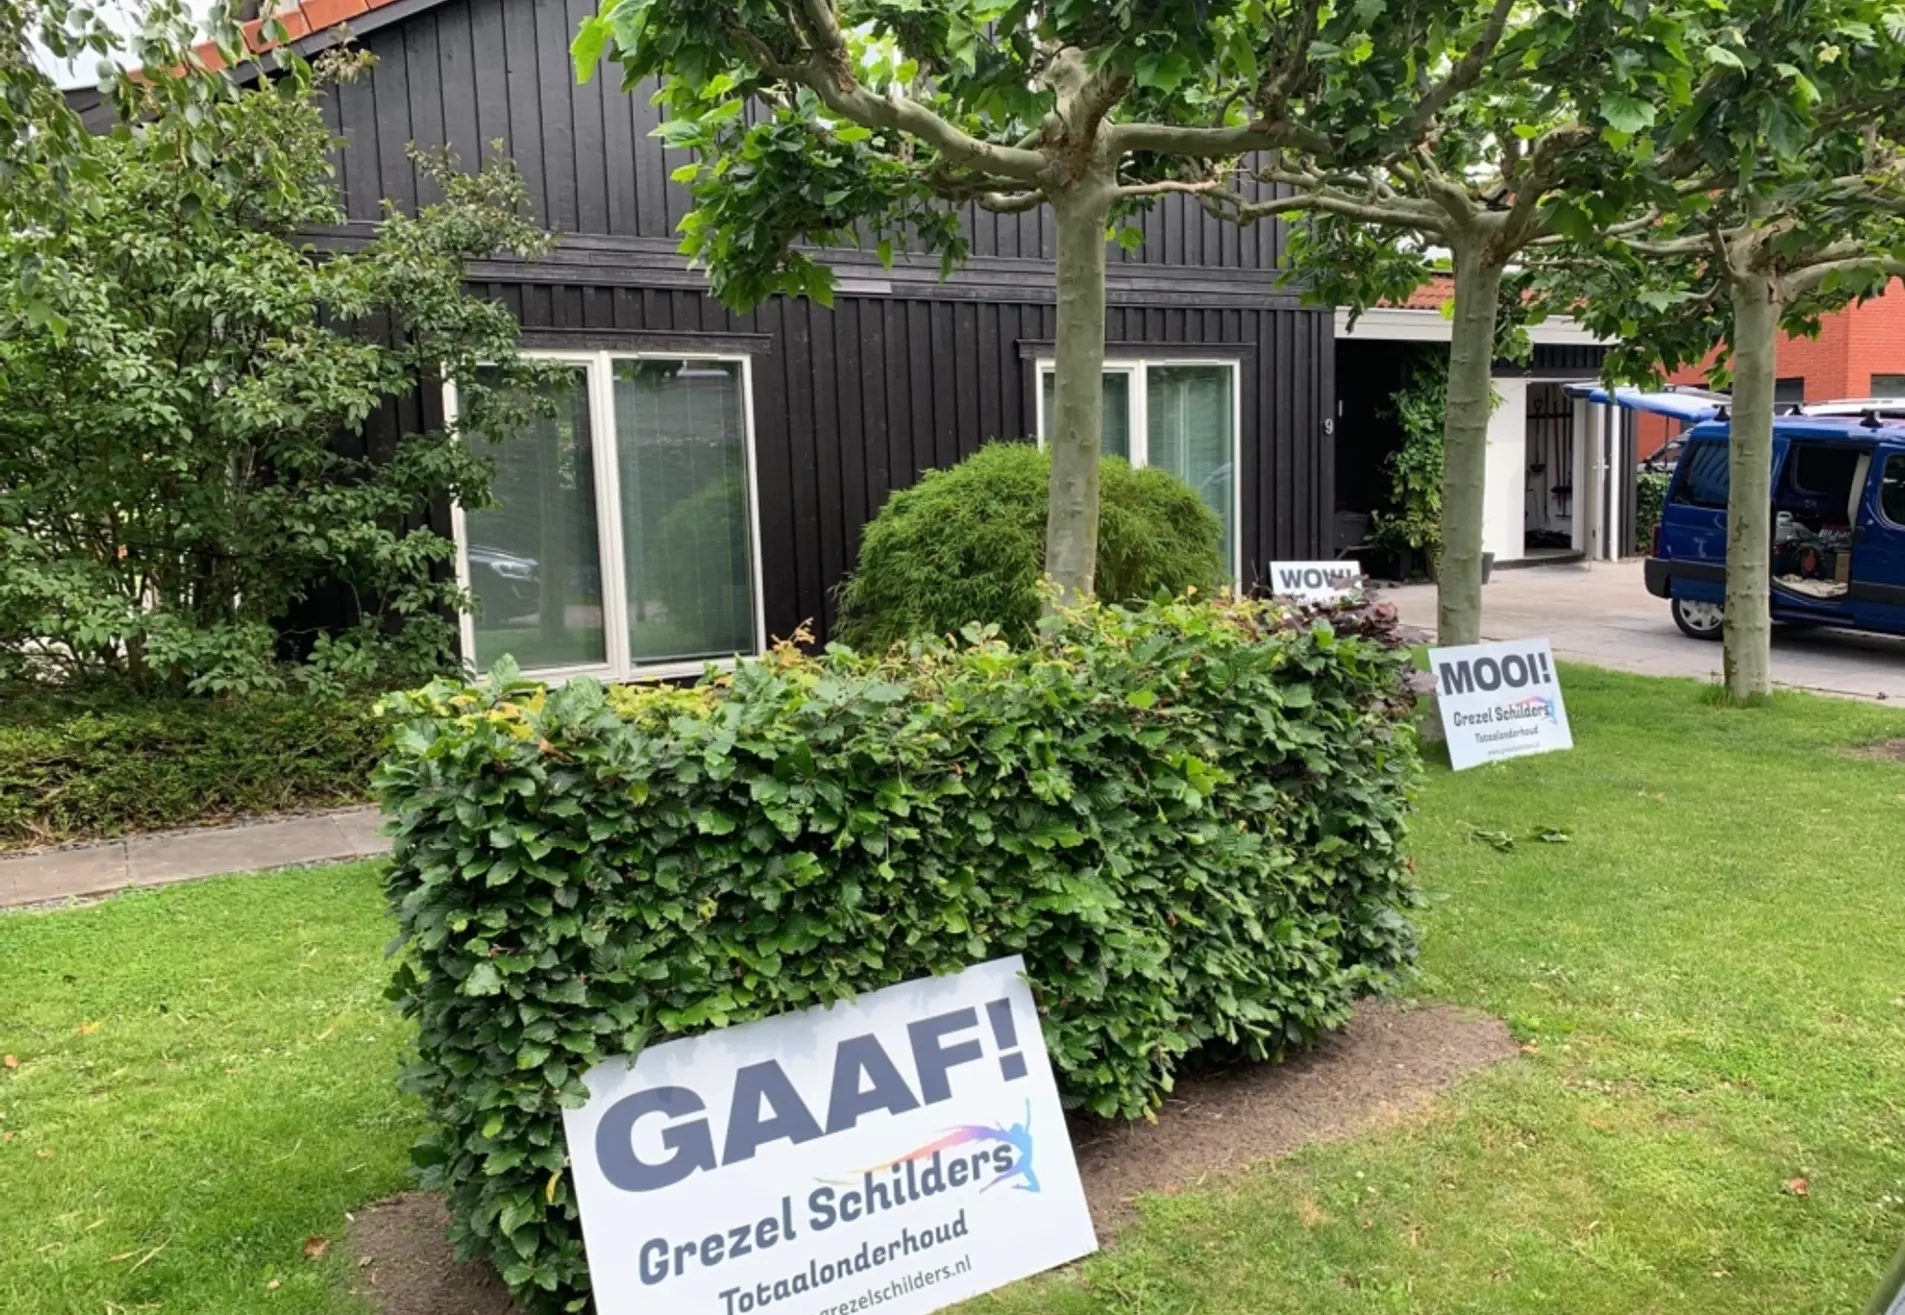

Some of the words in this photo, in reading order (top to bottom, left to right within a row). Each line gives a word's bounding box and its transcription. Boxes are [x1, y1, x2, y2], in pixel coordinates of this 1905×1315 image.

[1324, 418, 1333, 434] 9
[1439, 652, 1551, 695] MOOI!
[1453, 707, 1493, 727] Grezel
[1496, 702, 1550, 722] Schilders
[594, 997, 1028, 1193] GAAF!
[638, 1196, 797, 1286] Grezel
[807, 1143, 1013, 1231] Schilders
[718, 1209, 969, 1315] Totaalonderhoud
